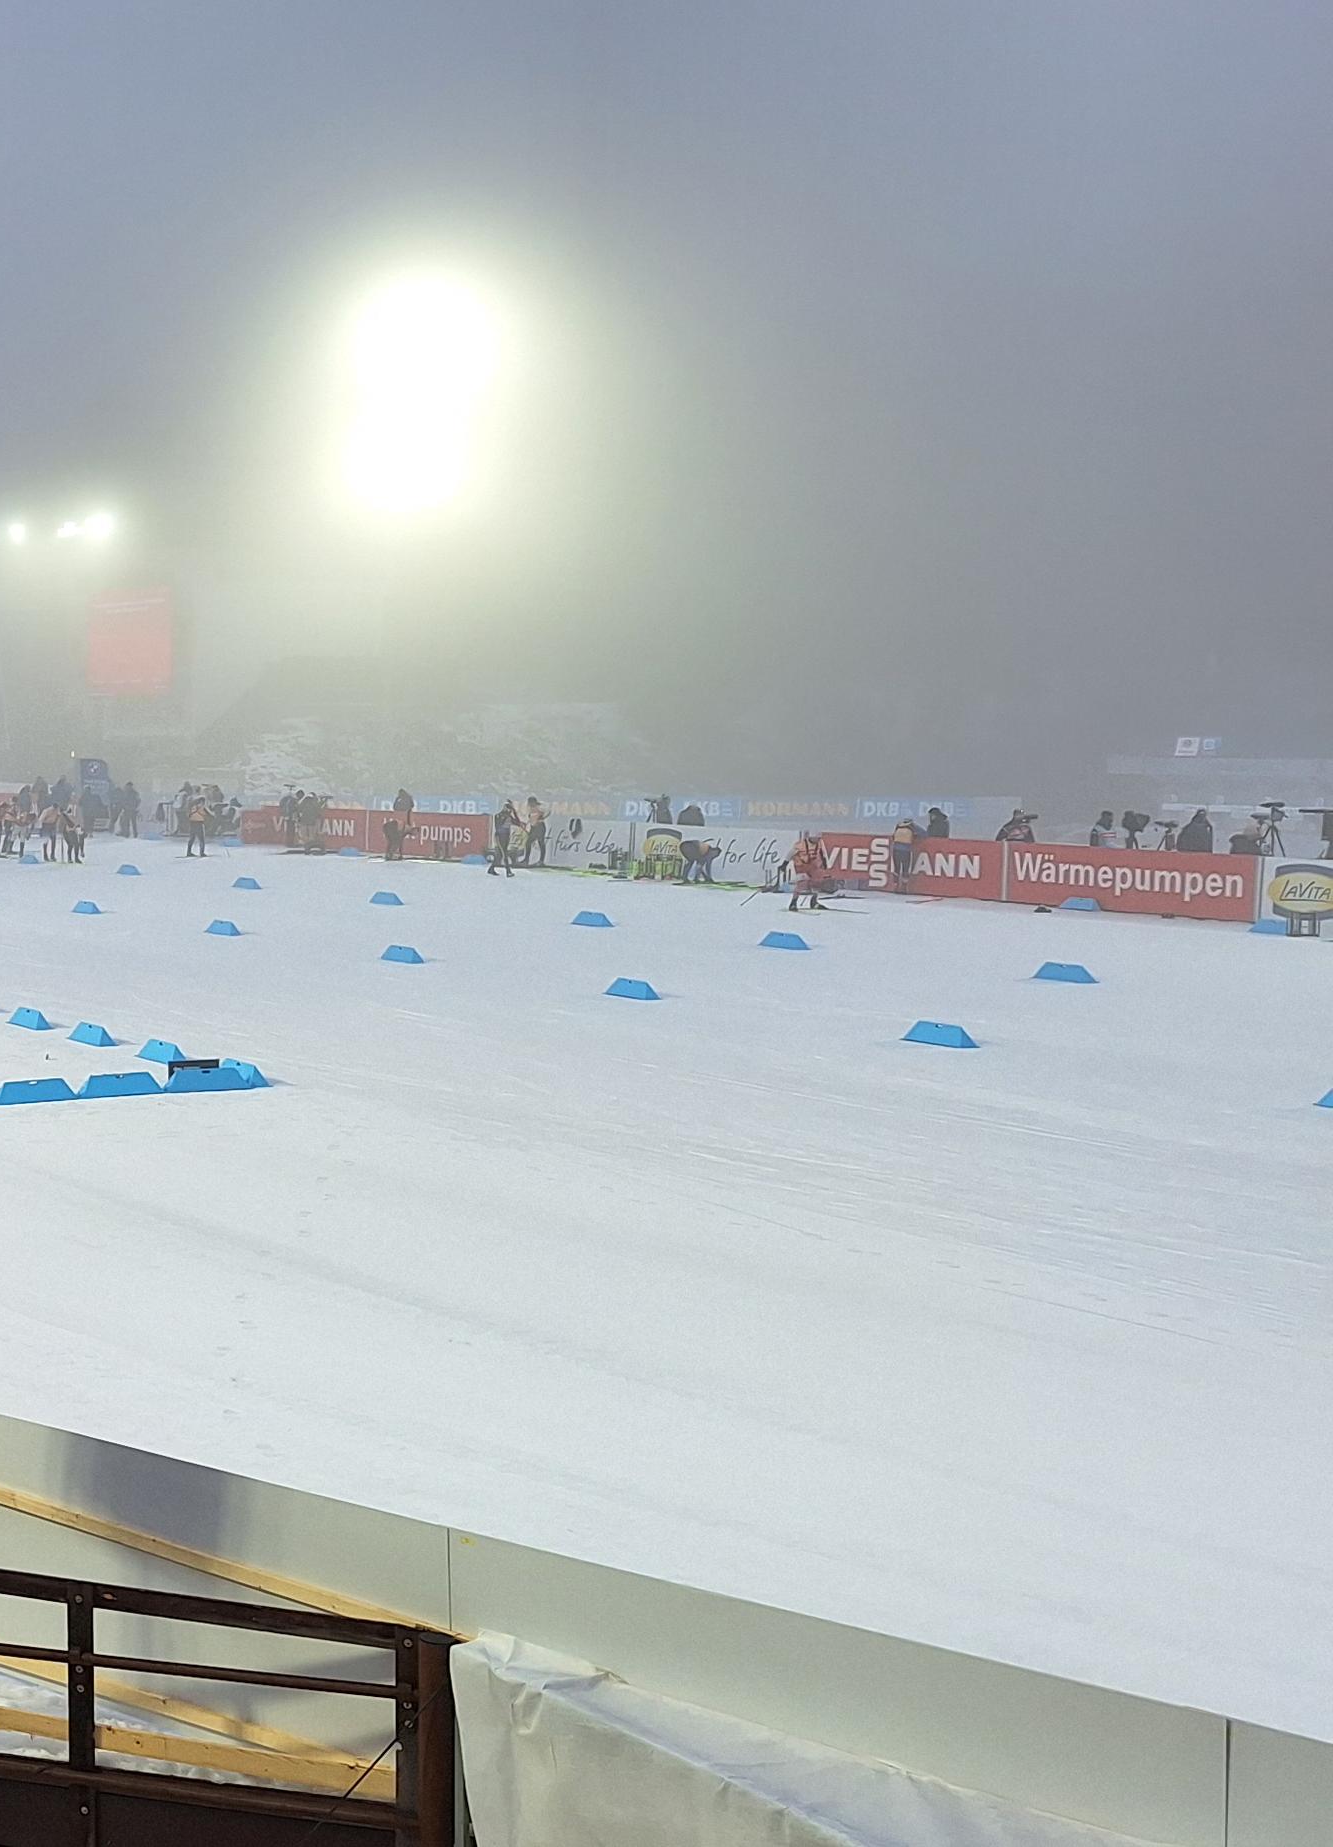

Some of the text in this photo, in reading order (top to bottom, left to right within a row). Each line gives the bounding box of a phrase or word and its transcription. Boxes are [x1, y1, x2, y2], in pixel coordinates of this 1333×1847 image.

[863, 802, 900, 817] DKB
[420, 824, 472, 847] pumps
[586, 829, 620, 854] Lebe
[722, 838, 781, 870] for life
[820, 838, 981, 888] VIESSANN
[1014, 851, 1244, 901] Wärmepumpen
